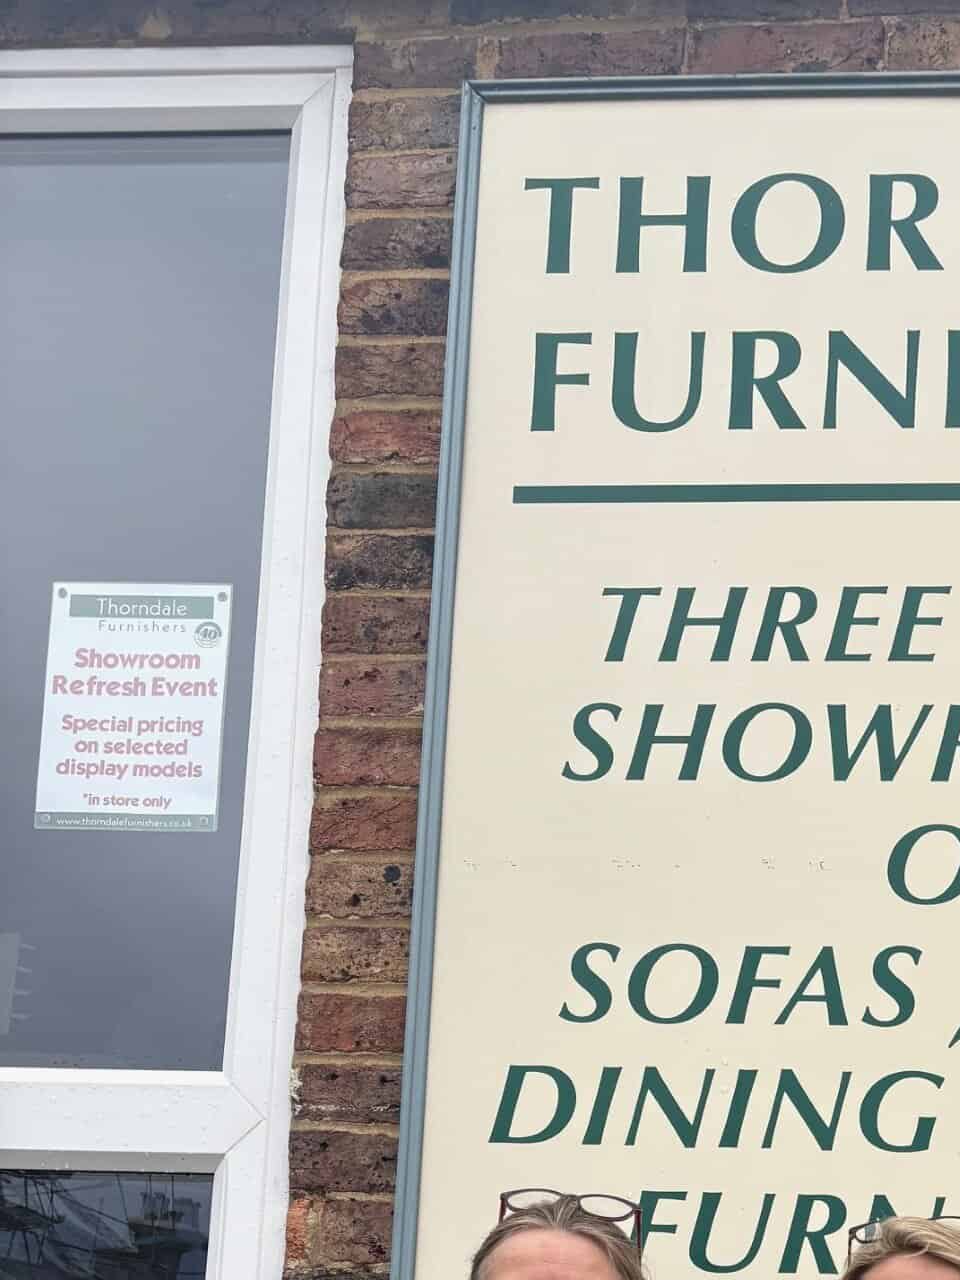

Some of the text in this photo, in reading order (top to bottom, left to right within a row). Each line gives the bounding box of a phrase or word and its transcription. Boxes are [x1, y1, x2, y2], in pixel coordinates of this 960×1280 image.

[96, 599, 188, 617] Thorndale
[98, 620, 187, 633] Furnishers
[604, 585, 950, 662] THREE
[74, 648, 201, 669] Showroom
[52, 675, 218, 697] Refresh Event
[61, 714, 204, 737] Special pricing
[74, 739, 188, 756] on selected
[55, 759, 203, 780] display models
[103, 796, 139, 807] store
[142, 796, 172, 809] only
[558, 943, 922, 1028] SOFAS
[488, 1064, 946, 1153] DINING
